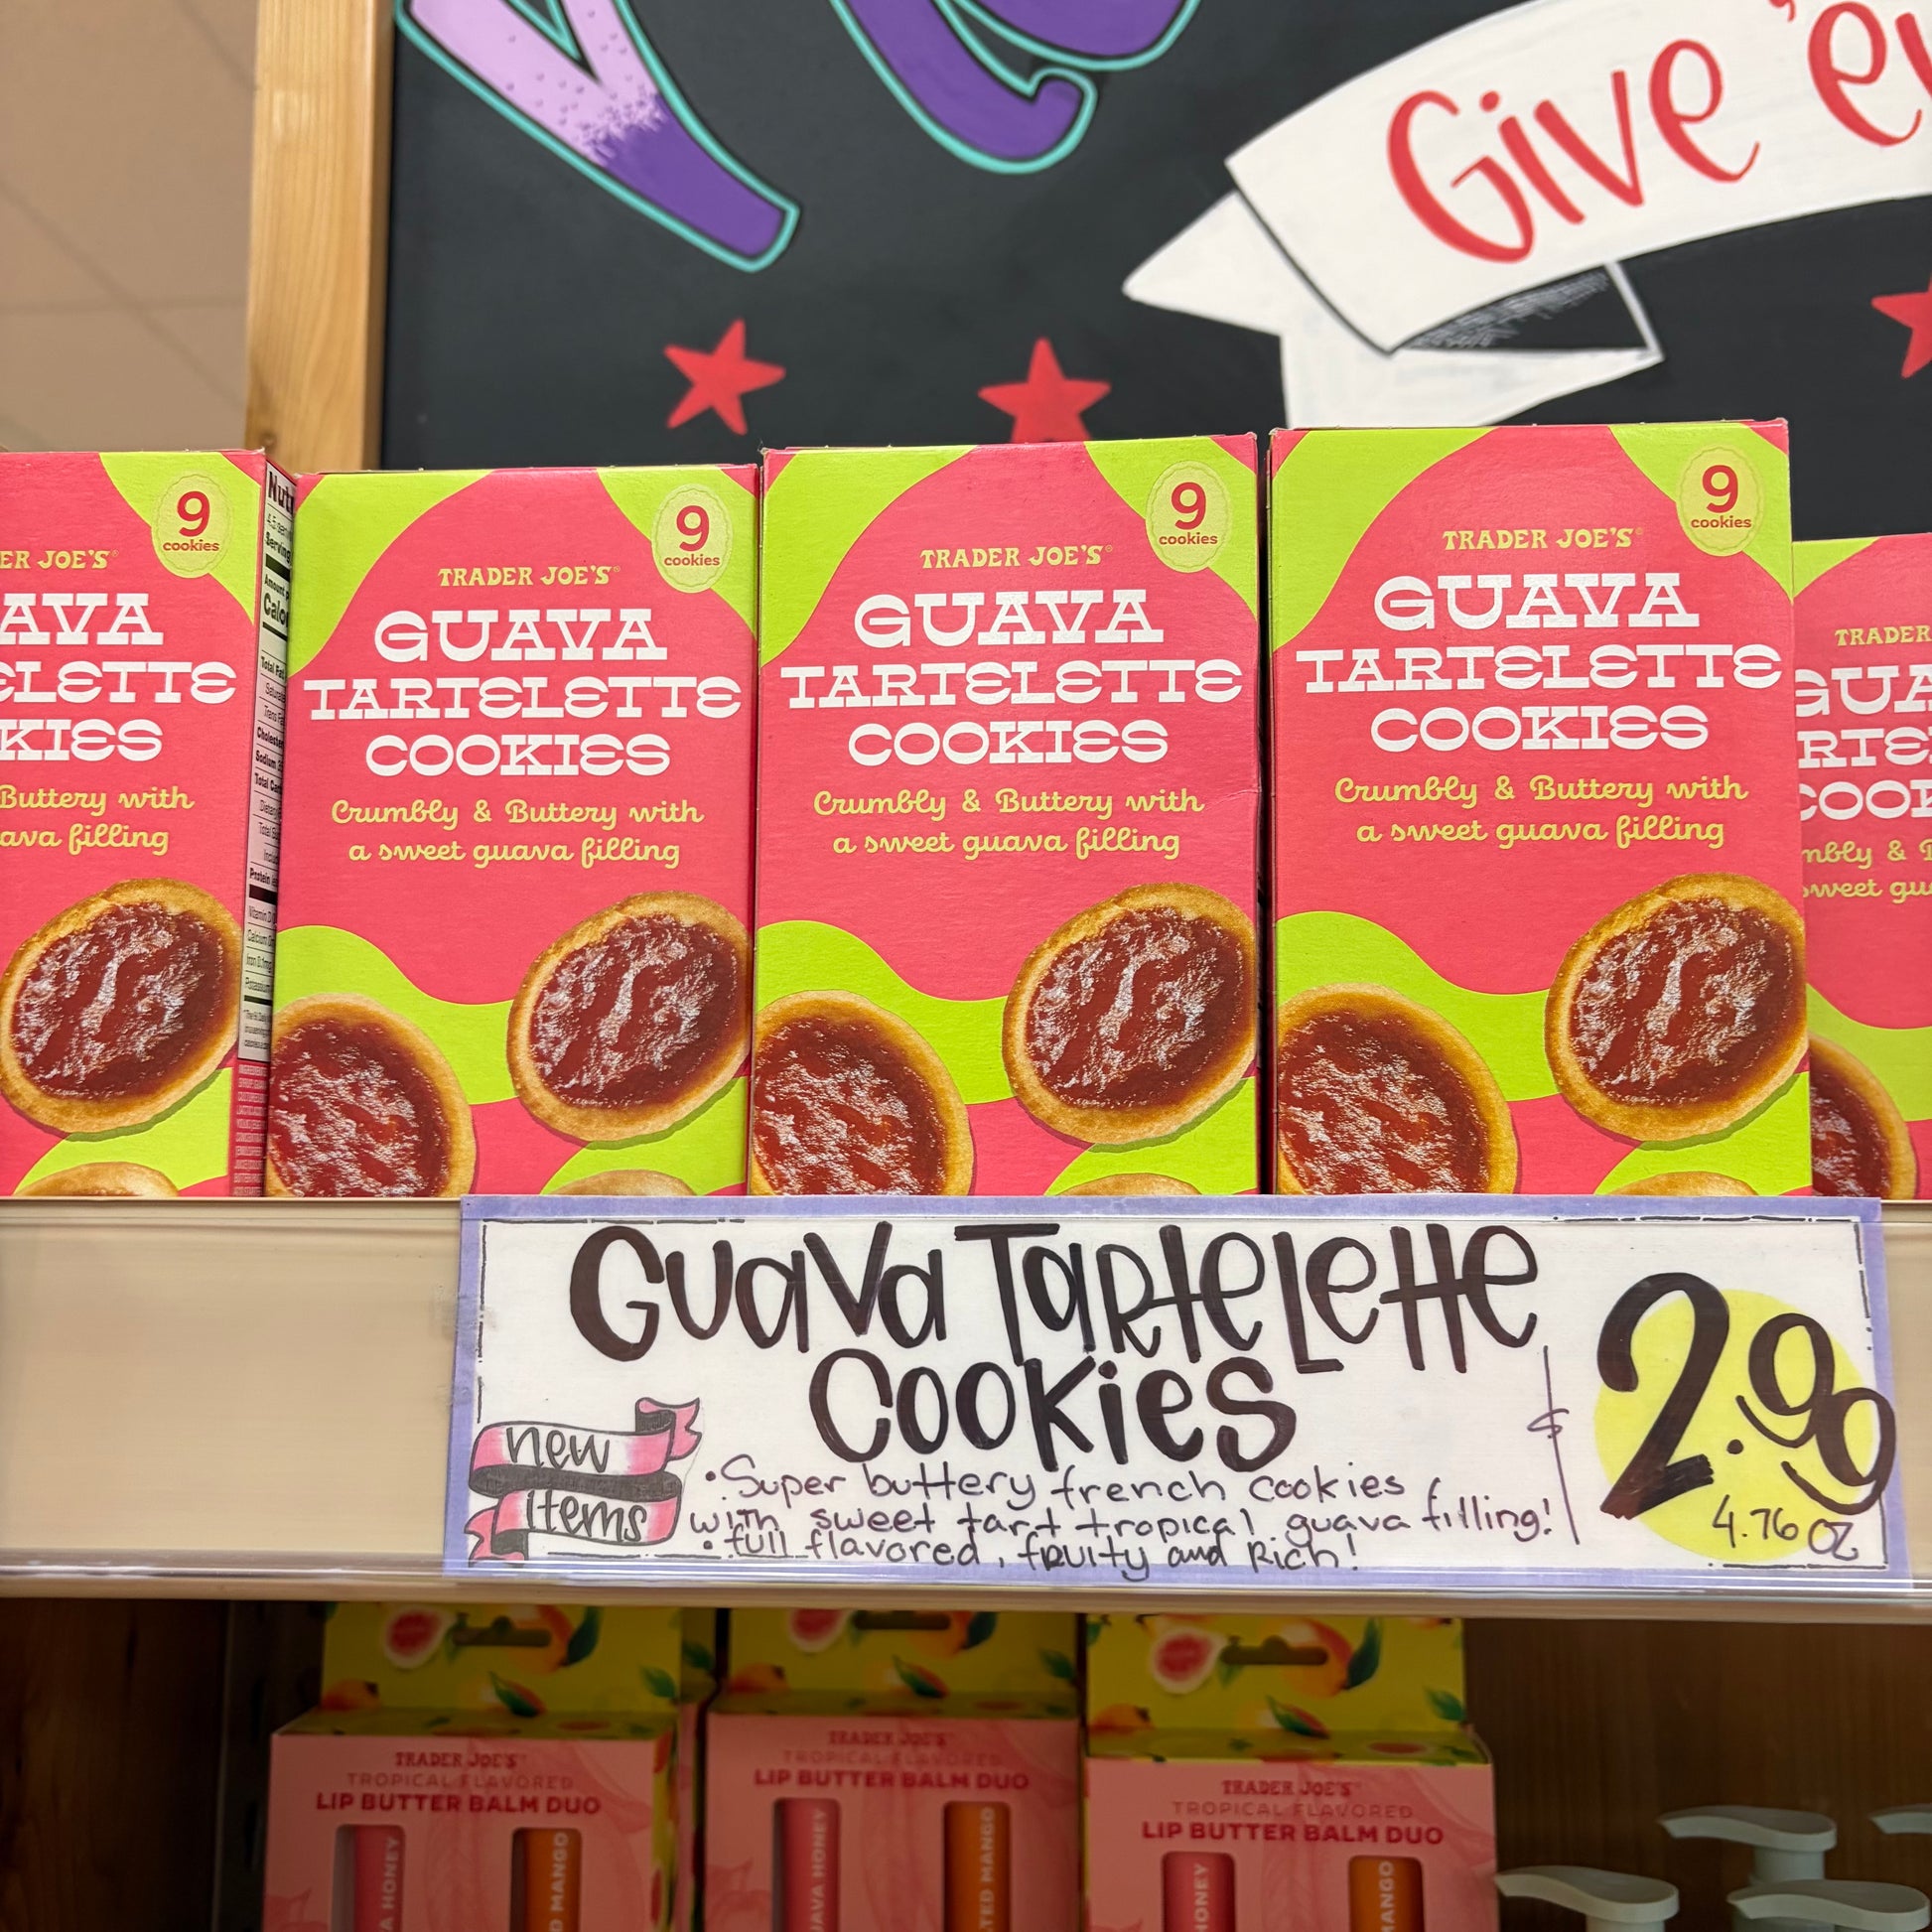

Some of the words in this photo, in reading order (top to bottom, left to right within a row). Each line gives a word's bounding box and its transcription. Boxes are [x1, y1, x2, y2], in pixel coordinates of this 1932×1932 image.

[1386, 38, 1760, 264] Give
[1171, 482, 1206, 529] 9
[1702, 465, 1738, 513] 9
[177, 490, 210, 537] 9
[676, 505, 709, 551] 9
[1690, 515, 1751, 530] cookies
[162, 538, 220, 552] cookies
[1159, 531, 1218, 546] cookies
[1443, 529, 1549, 551] TRADER
[1556, 526, 1634, 549] JOE'S
[664, 554, 720, 567] cookies
[920, 547, 1022, 569] TRADER
[1029, 545, 1103, 566] JOE'S
[265, 574, 285, 596] Amount
[438, 568, 533, 586] TRADER
[540, 566, 612, 585] JOE'S
[0, 593, 164, 645] AVA
[854, 589, 1164, 648] GUAVA
[1374, 572, 1700, 631] GUAVA
[374, 609, 667, 662] GUAVA
[1835, 624, 1932, 646] TRADER
[261, 655, 274, 673] Total
[1296, 643, 1782, 694] TARTELETTE
[304, 676, 742, 720] TARTELETTE
[780, 658, 1242, 709] TARTELETTE
[0, 719, 164, 761] KIES
[848, 719, 1169, 765] COOKIES
[1370, 704, 1709, 753] COOKIES
[255, 750, 277, 769] Sodium
[365, 733, 670, 776] COOKIES
[1797, 726, 1932, 769] RTE
[254, 772, 269, 788] Total
[1334, 775, 1478, 809] Crumbly
[1494, 776, 1515, 800] &
[1530, 774, 1653, 807] Buttery
[1666, 773, 1748, 801] with
[0, 784, 107, 817] Buttery
[118, 785, 196, 810] with
[332, 799, 459, 830] Crumbly
[474, 801, 491, 823] &
[504, 800, 618, 829] Buttery
[628, 799, 704, 823] with
[813, 789, 946, 821] Crumbly
[962, 789, 981, 812] &
[996, 787, 1112, 819] Buttery
[1125, 786, 1205, 813] with
[69, 823, 170, 856] filling
[258, 822, 271, 838] Total
[833, 834, 856, 854] a
[865, 830, 954, 854] sweet
[962, 831, 1068, 861] guava
[1075, 826, 1180, 861] filling
[1356, 821, 1382, 842] a
[1391, 818, 1488, 842] sweet
[1495, 819, 1608, 850] guava
[1615, 814, 1725, 849] filling
[348, 842, 370, 861] a
[379, 839, 466, 861] sweet
[473, 841, 574, 868] guava
[582, 837, 680, 869] filling
[1887, 839, 1906, 862] &
[249, 867, 271, 885] Protein
[1889, 881, 1932, 904] gu
[1596, 1272, 1897, 1520] 2.99
[505, 1426, 610, 1473] new
[721, 1454, 846, 1507] Super
[863, 1461, 1035, 1510] buttery
[1050, 1464, 1226, 1508] french
[690, 1507, 779, 1534] with
[810, 1503, 935, 1533] sweet
[957, 1502, 1061, 1535] tart
[1075, 1507, 1254, 1547] tropical
[1285, 1512, 1411, 1548] guava
[1421, 1477, 1553, 1542] filling!
[1712, 1494, 1799, 1549] 4.76
[725, 1529, 787, 1557] full
[1168, 1533, 1227, 1567] and
[828, 1730, 893, 1746] TRADER
[394, 1751, 463, 1768] TRADER
[783, 1749, 884, 1764] TROPICAL
[894, 1751, 1001, 1766] FLAVORED
[346, 1772, 451, 1788] TROPICAL
[460, 1773, 574, 1790] FLAVORED
[755, 1768, 791, 1785] LIP
[798, 1770, 893, 1787] BUTTER
[900, 1771, 968, 1788] BALM
[978, 1773, 1029, 1789] DUO
[1222, 1779, 1293, 1796] TRADER
[316, 1792, 353, 1811] LIP
[361, 1793, 462, 1813] BUTTER
[469, 1794, 539, 1813] BALM
[546, 1795, 601, 1814] DUO
[1173, 1800, 1283, 1817] TROPICAL
[1294, 1803, 1413, 1819] FLAVORED
[811, 1808, 828, 1878] HONEY
[981, 1807, 996, 1882] MANGO
[1142, 1821, 1182, 1839] LIP
[1189, 1823, 1296, 1842] BUTTER
[1304, 1825, 1378, 1843] BALM
[1385, 1826, 1444, 1846] DUO
[381, 1837, 400, 1909] HONEY
[550, 1832, 570, 1911] MANGO
[979, 1888, 994, 1932] TED
